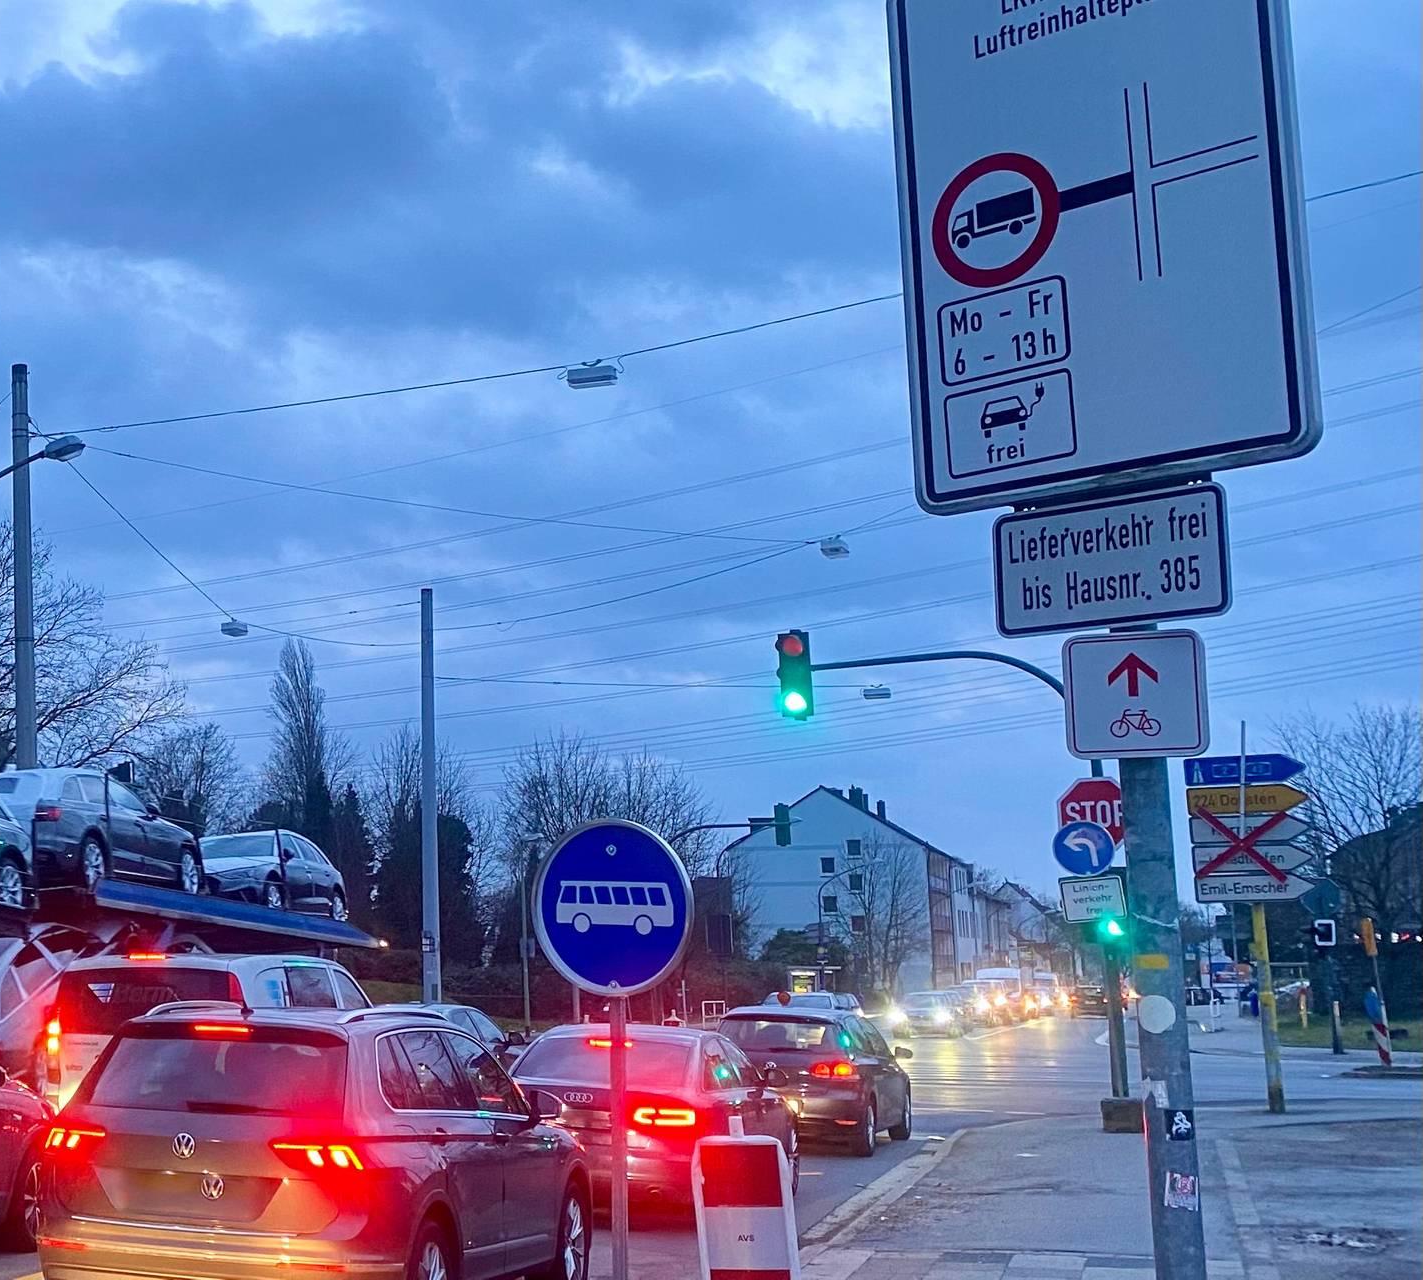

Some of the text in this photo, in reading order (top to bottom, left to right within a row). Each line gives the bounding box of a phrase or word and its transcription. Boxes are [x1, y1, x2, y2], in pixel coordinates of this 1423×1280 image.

[973, 0, 1151, 59] Luftreinhaltep
[949, 289, 1054, 338] Mo - Fr
[954, 347, 966, 376] 6
[986, 437, 1025, 464] frei
[1008, 502, 1208, 564] Lieferverkehr frei
[1022, 555, 1201, 610] bis Hausnr. 385
[1220, 793, 1277, 807] Dosten
[1073, 895, 1113, 904] verkehr
[1200, 882, 1290, 895] Emil-Emscher
[737, 1234, 755, 1242] AVS
